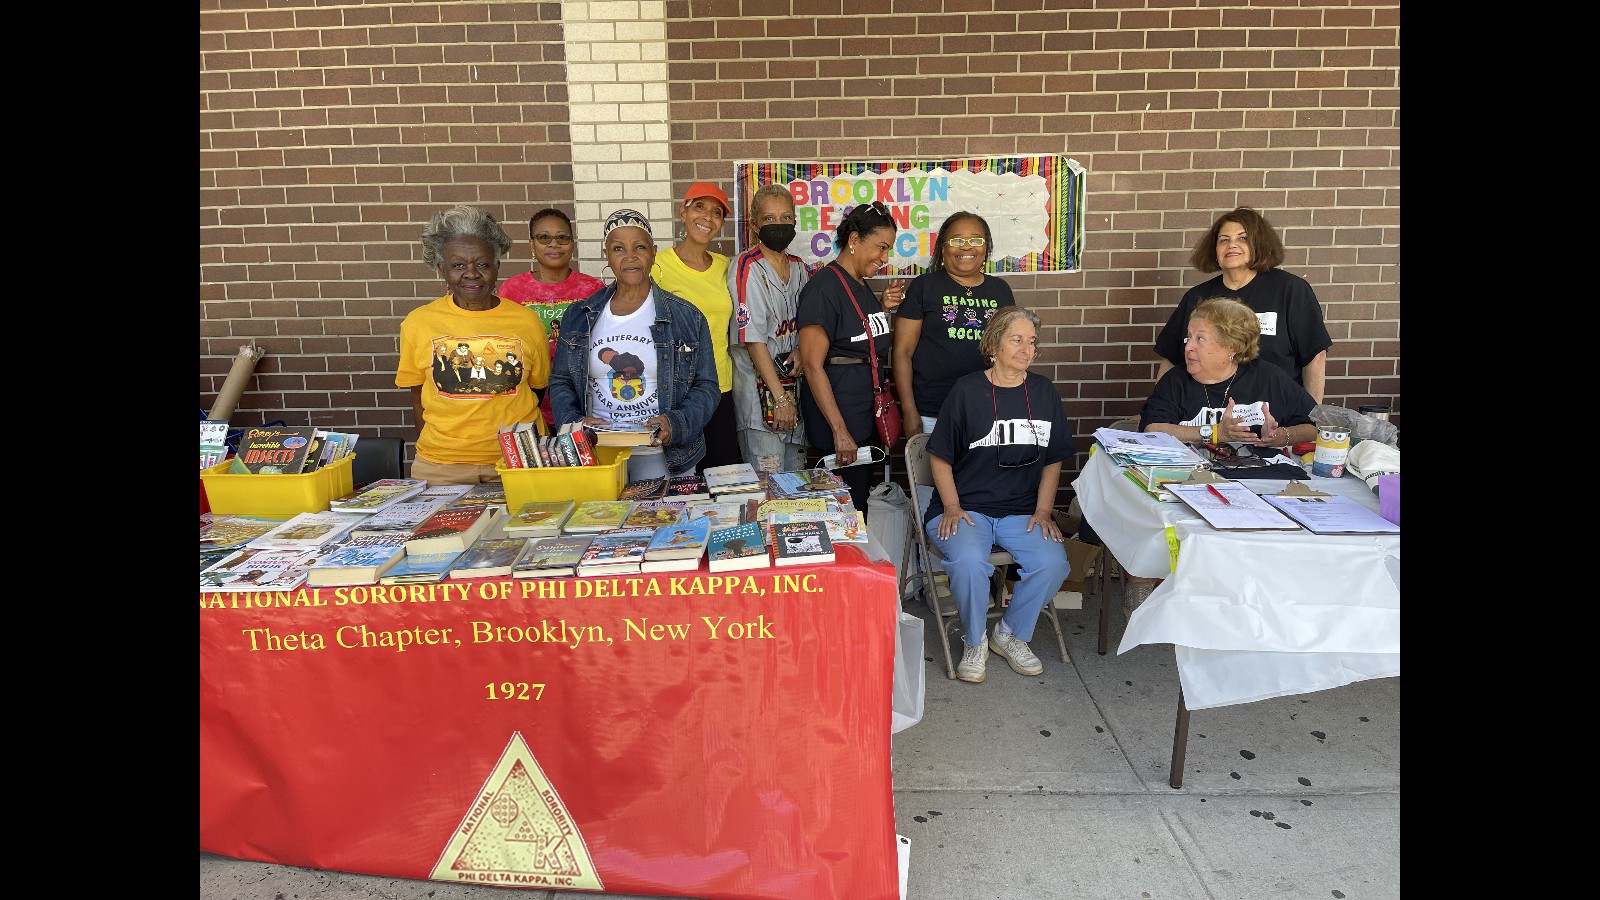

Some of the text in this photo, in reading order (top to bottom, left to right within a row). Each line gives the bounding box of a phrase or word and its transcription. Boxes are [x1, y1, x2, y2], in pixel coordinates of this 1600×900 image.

[789, 176, 948, 206] BROOKLYN
[800, 204, 930, 232] RENG
[942, 295, 998, 308] READING
[543, 307, 567, 319] 192
[590, 334, 653, 351] AR LITERARY
[948, 327, 984, 341] ROCK
[596, 388, 613, 410] YEAR
[335, 582, 472, 606] SORORITY
[479, 581, 513, 601] OF
[521, 580, 567, 600] PHI
[574, 578, 663, 599] DELTA
[669, 575, 765, 597] KAPPA,
[773, 574, 824, 594] INC.
[242, 614, 776, 653] Theta Chapter, Brooklyn, New York
[484, 682, 546, 701] 1927
[461, 791, 495, 836] NATIONAL
[541, 789, 573, 837] SORORITY
[458, 872, 577, 887] PHI DELTA KAPPA, INC.
